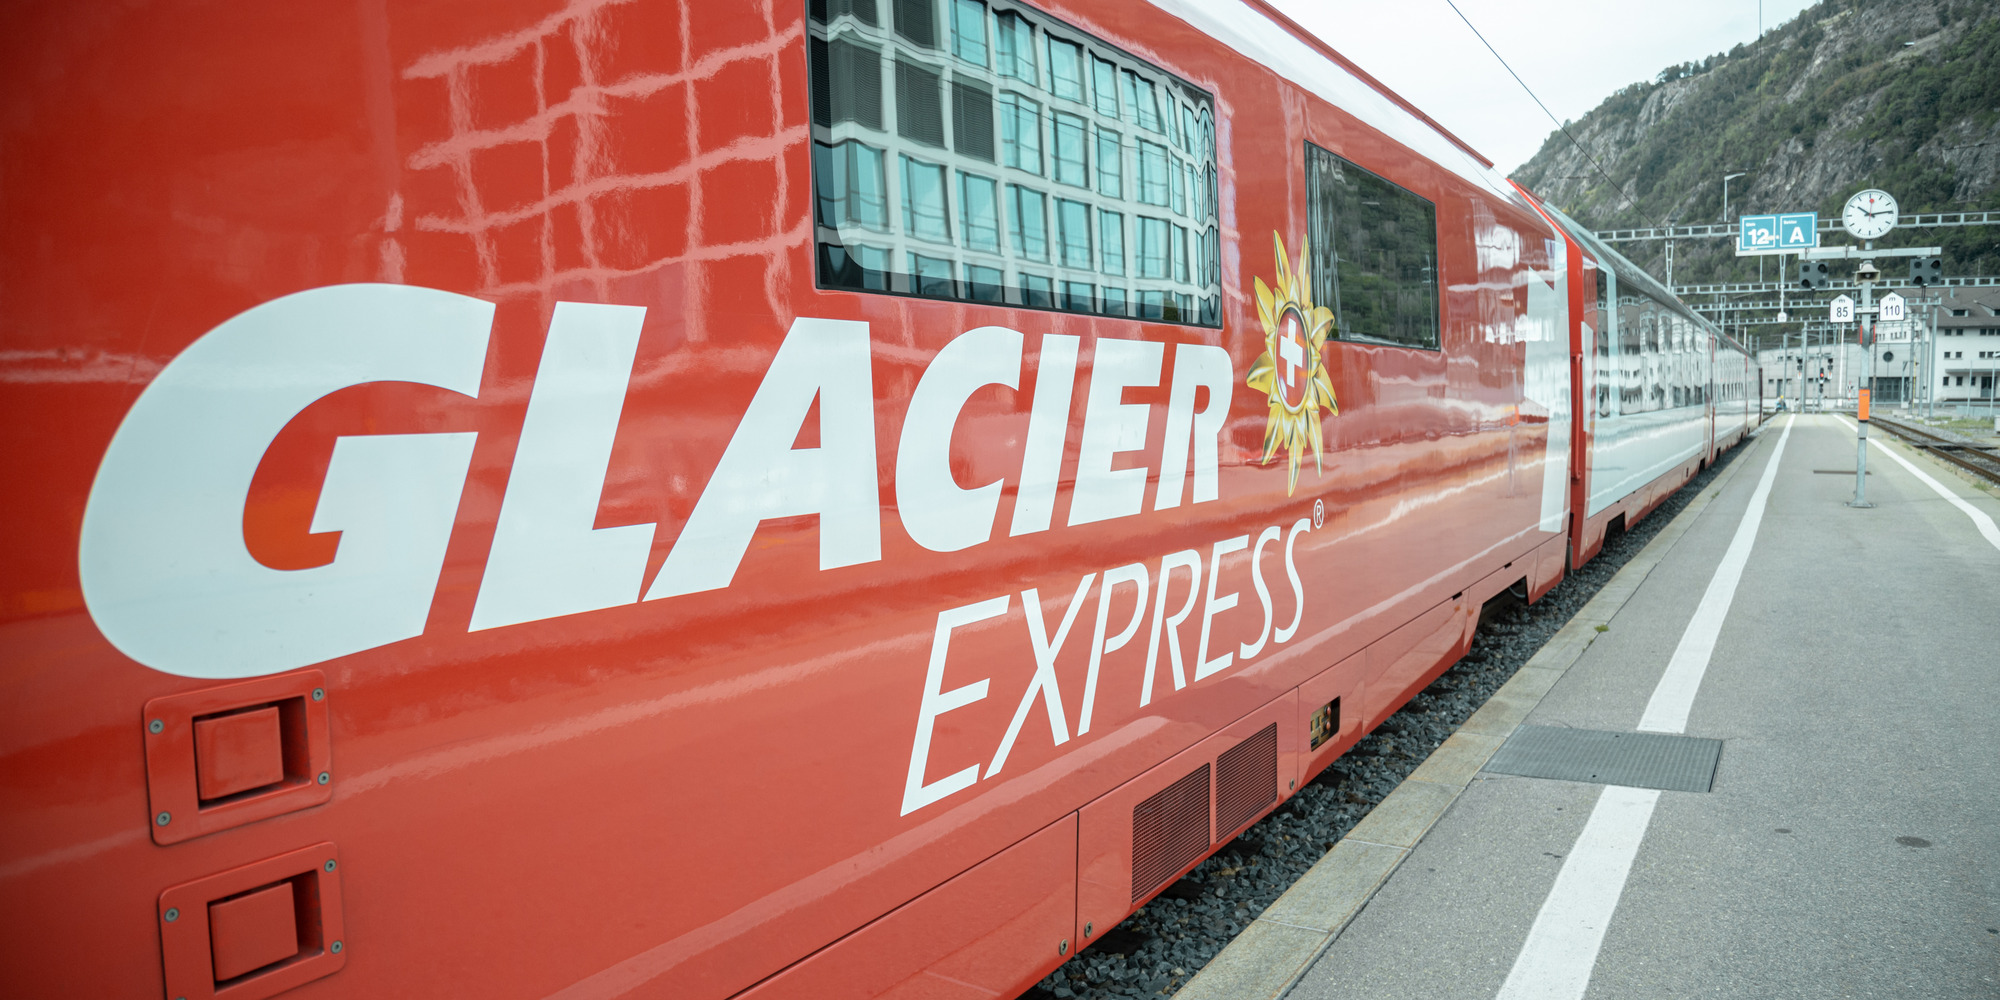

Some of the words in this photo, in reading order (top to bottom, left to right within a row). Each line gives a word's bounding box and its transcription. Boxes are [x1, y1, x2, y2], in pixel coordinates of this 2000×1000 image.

[1747, 228, 1770, 246] 12
[1789, 226, 1805, 243] A
[1836, 306, 1849, 318] 85
[1884, 304, 1901, 316] 110
[79, 282, 1234, 680] GLACIER
